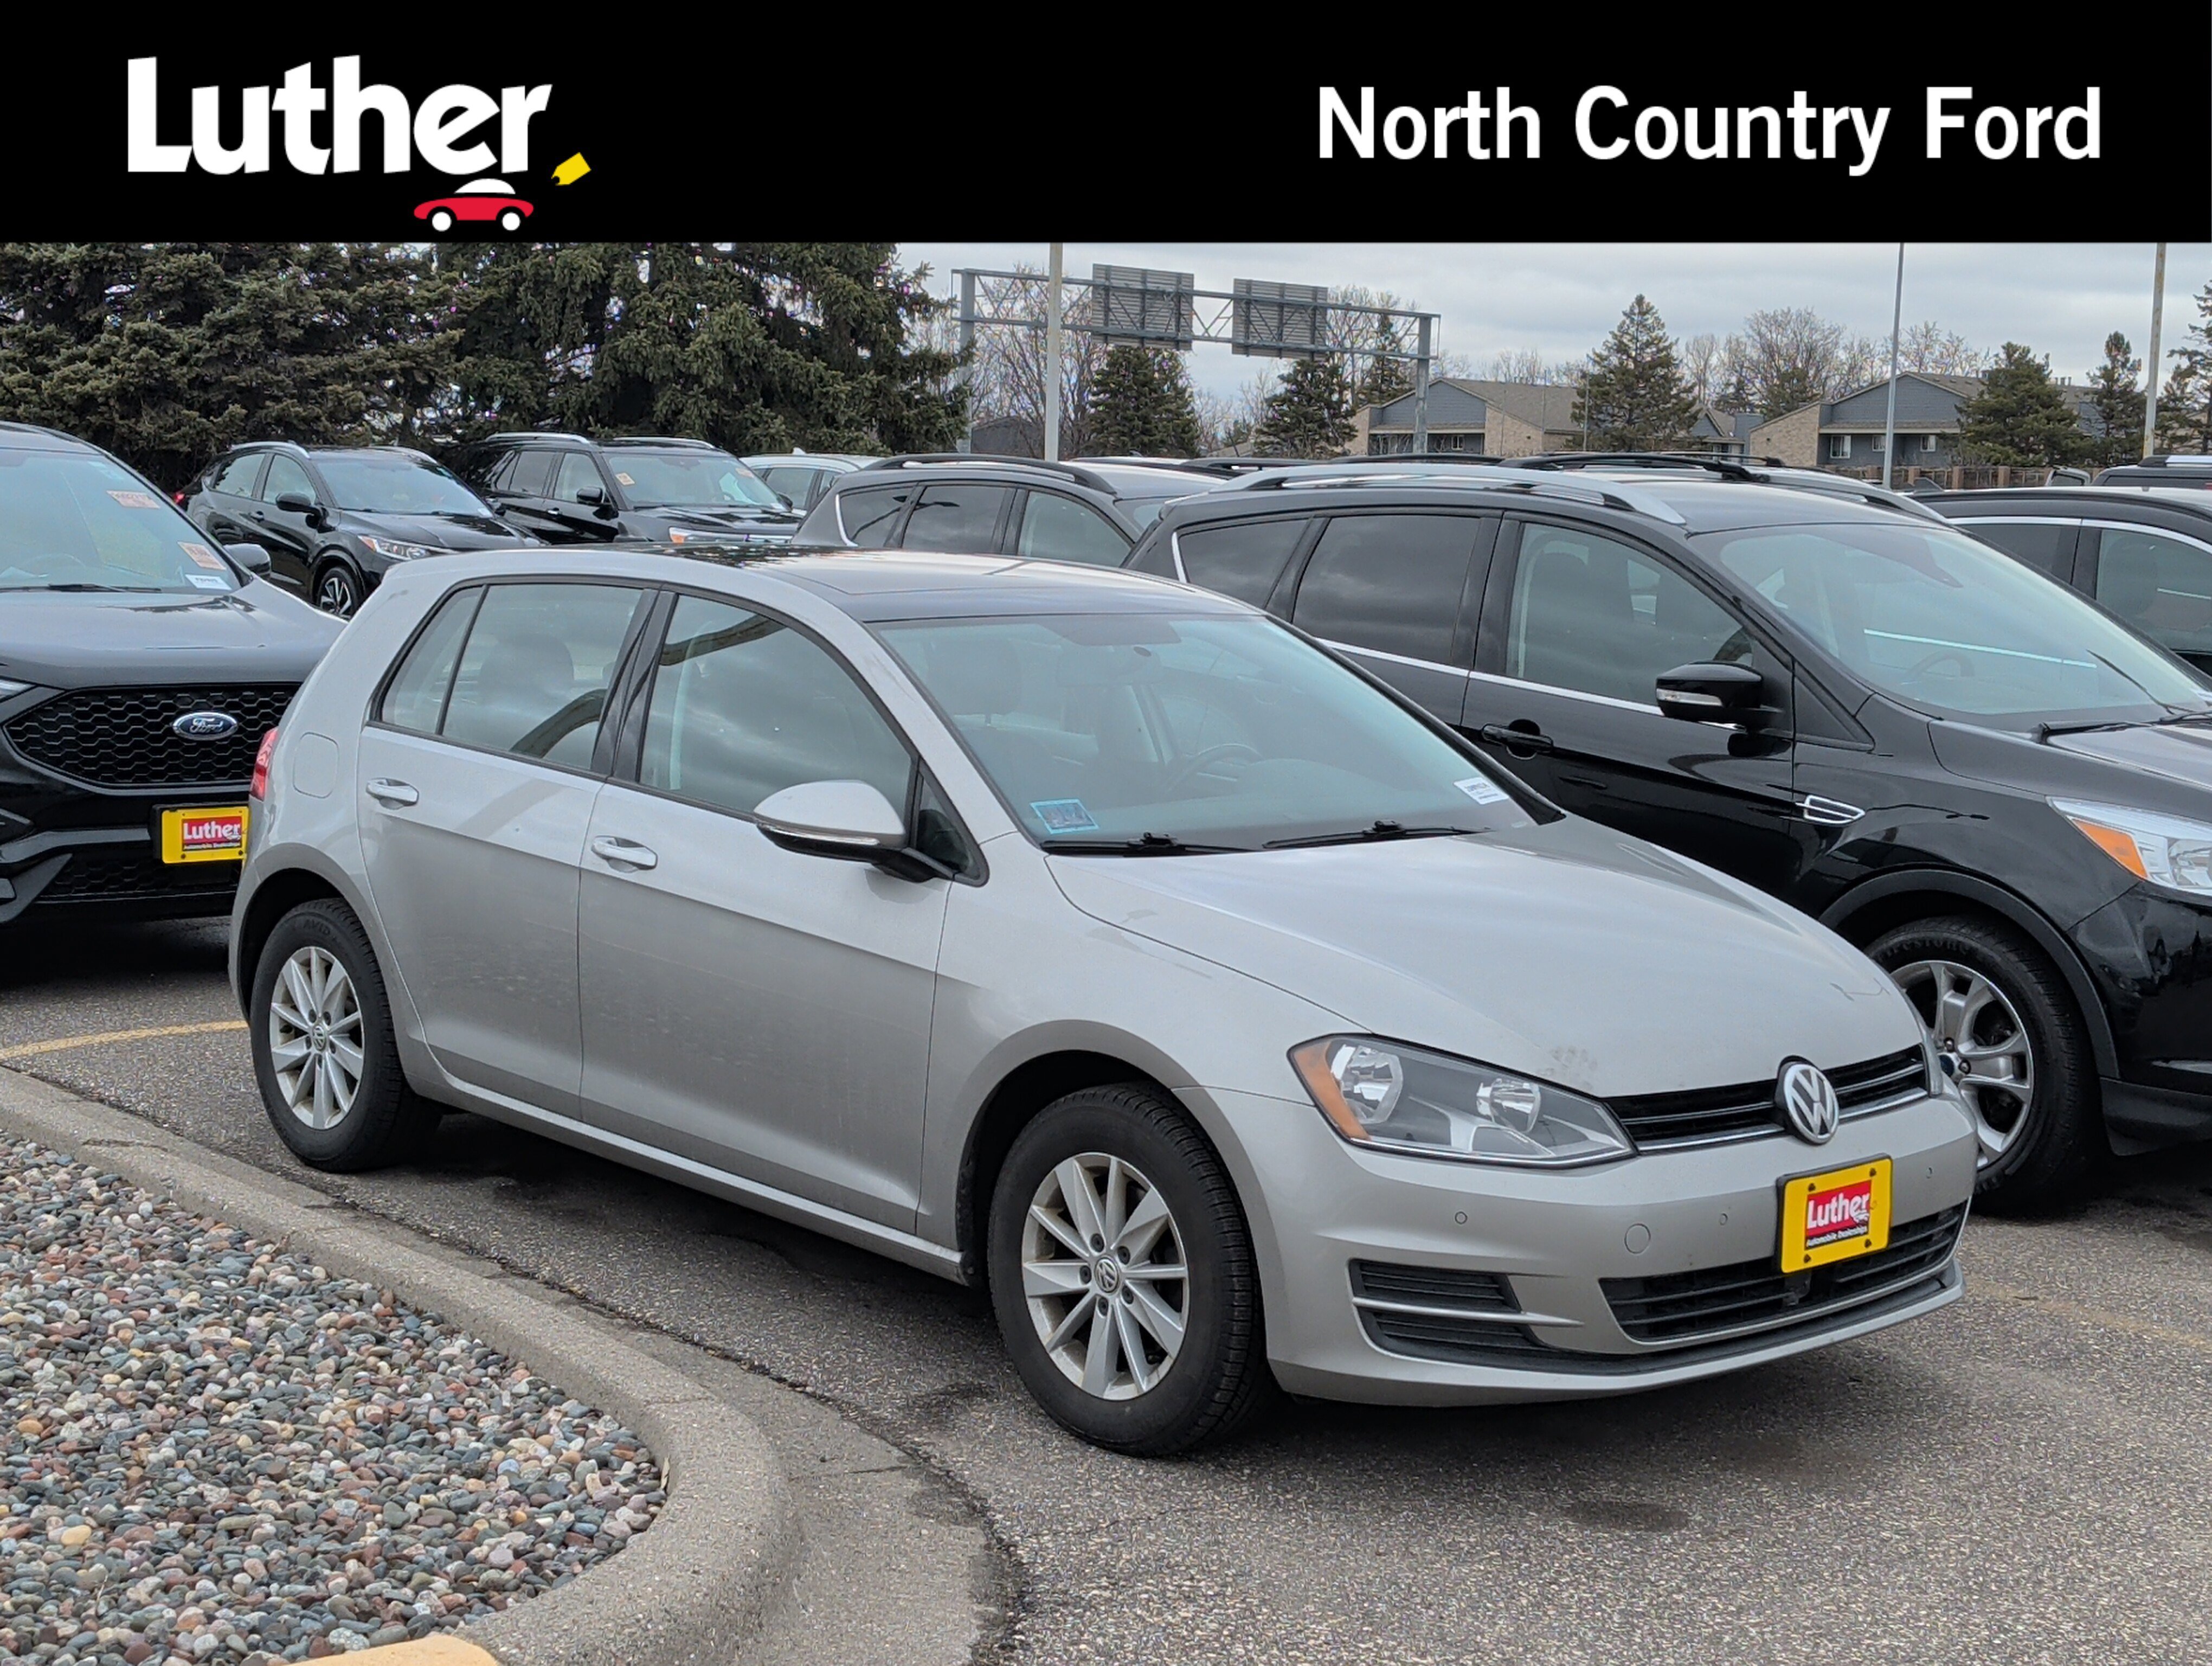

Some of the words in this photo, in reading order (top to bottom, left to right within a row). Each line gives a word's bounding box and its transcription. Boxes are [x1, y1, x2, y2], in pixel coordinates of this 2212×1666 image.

[189, 717, 224, 734] Ford
[183, 821, 241, 840] Luther
[1807, 1192, 1870, 1229] Luther
